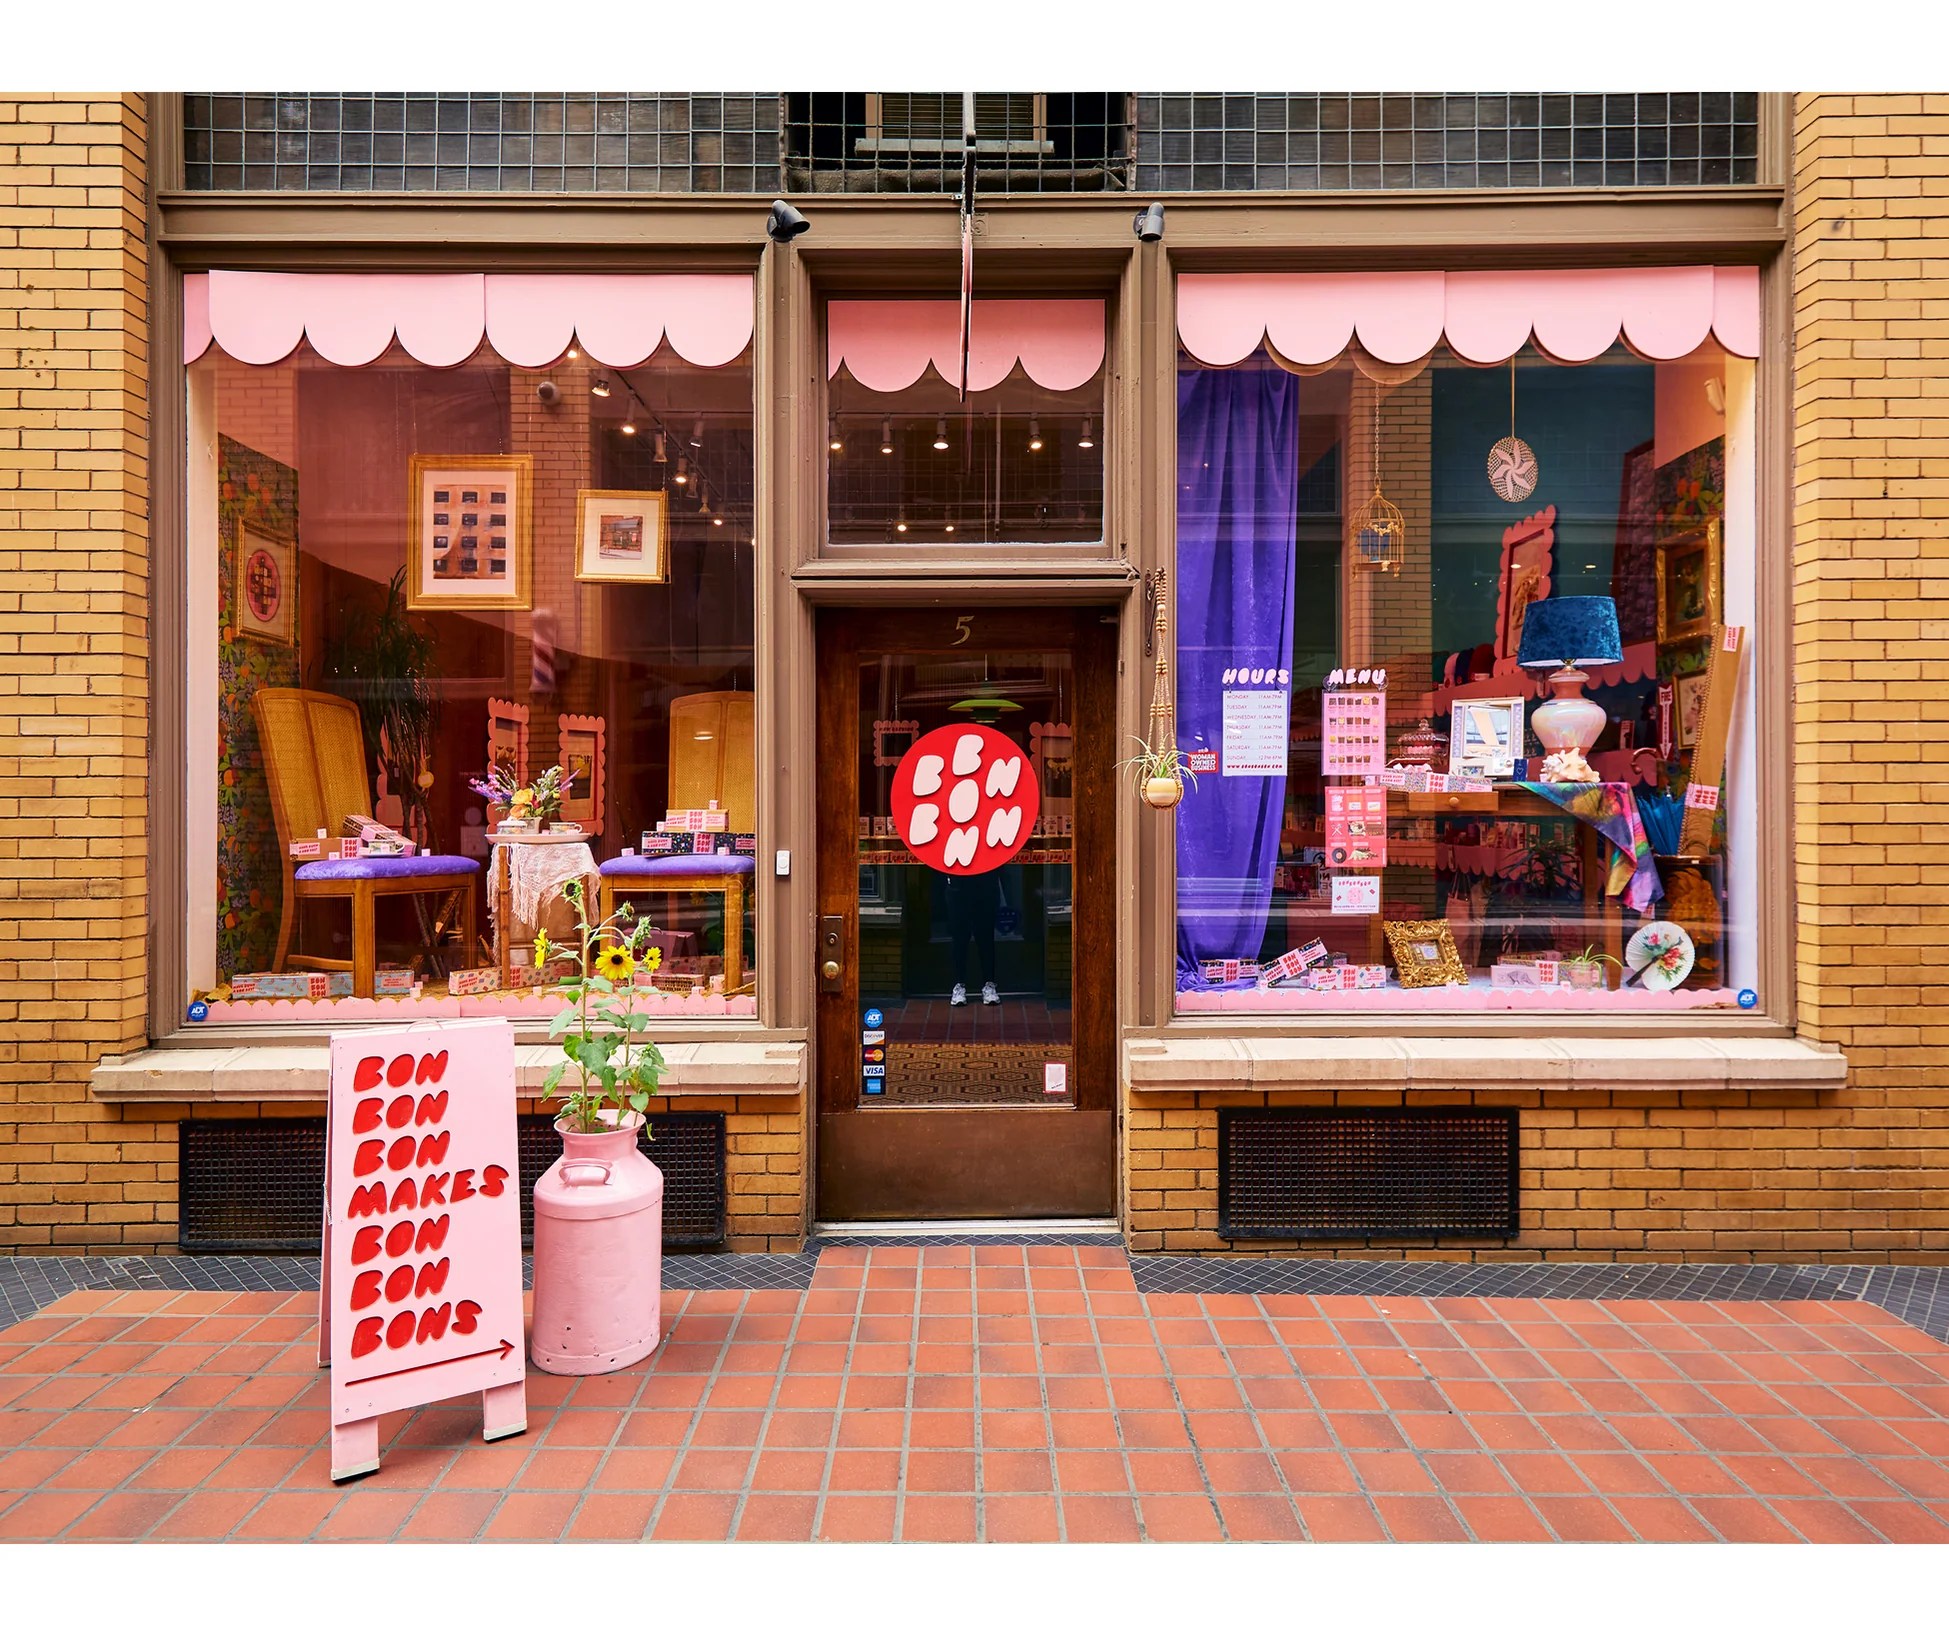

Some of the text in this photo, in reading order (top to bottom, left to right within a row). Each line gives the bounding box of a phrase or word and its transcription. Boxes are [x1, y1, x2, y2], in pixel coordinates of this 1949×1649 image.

[950, 615, 975, 646] 5
[1222, 667, 1289, 685] HOURS
[1329, 668, 1386, 685] MENU
[353, 1050, 449, 1092] BON
[352, 1090, 449, 1135] BON
[353, 1130, 450, 1178] BON
[348, 1164, 510, 1219] MAKES
[351, 1213, 450, 1266] BON
[350, 1256, 450, 1312] BON
[351, 1299, 483, 1360] BONS
